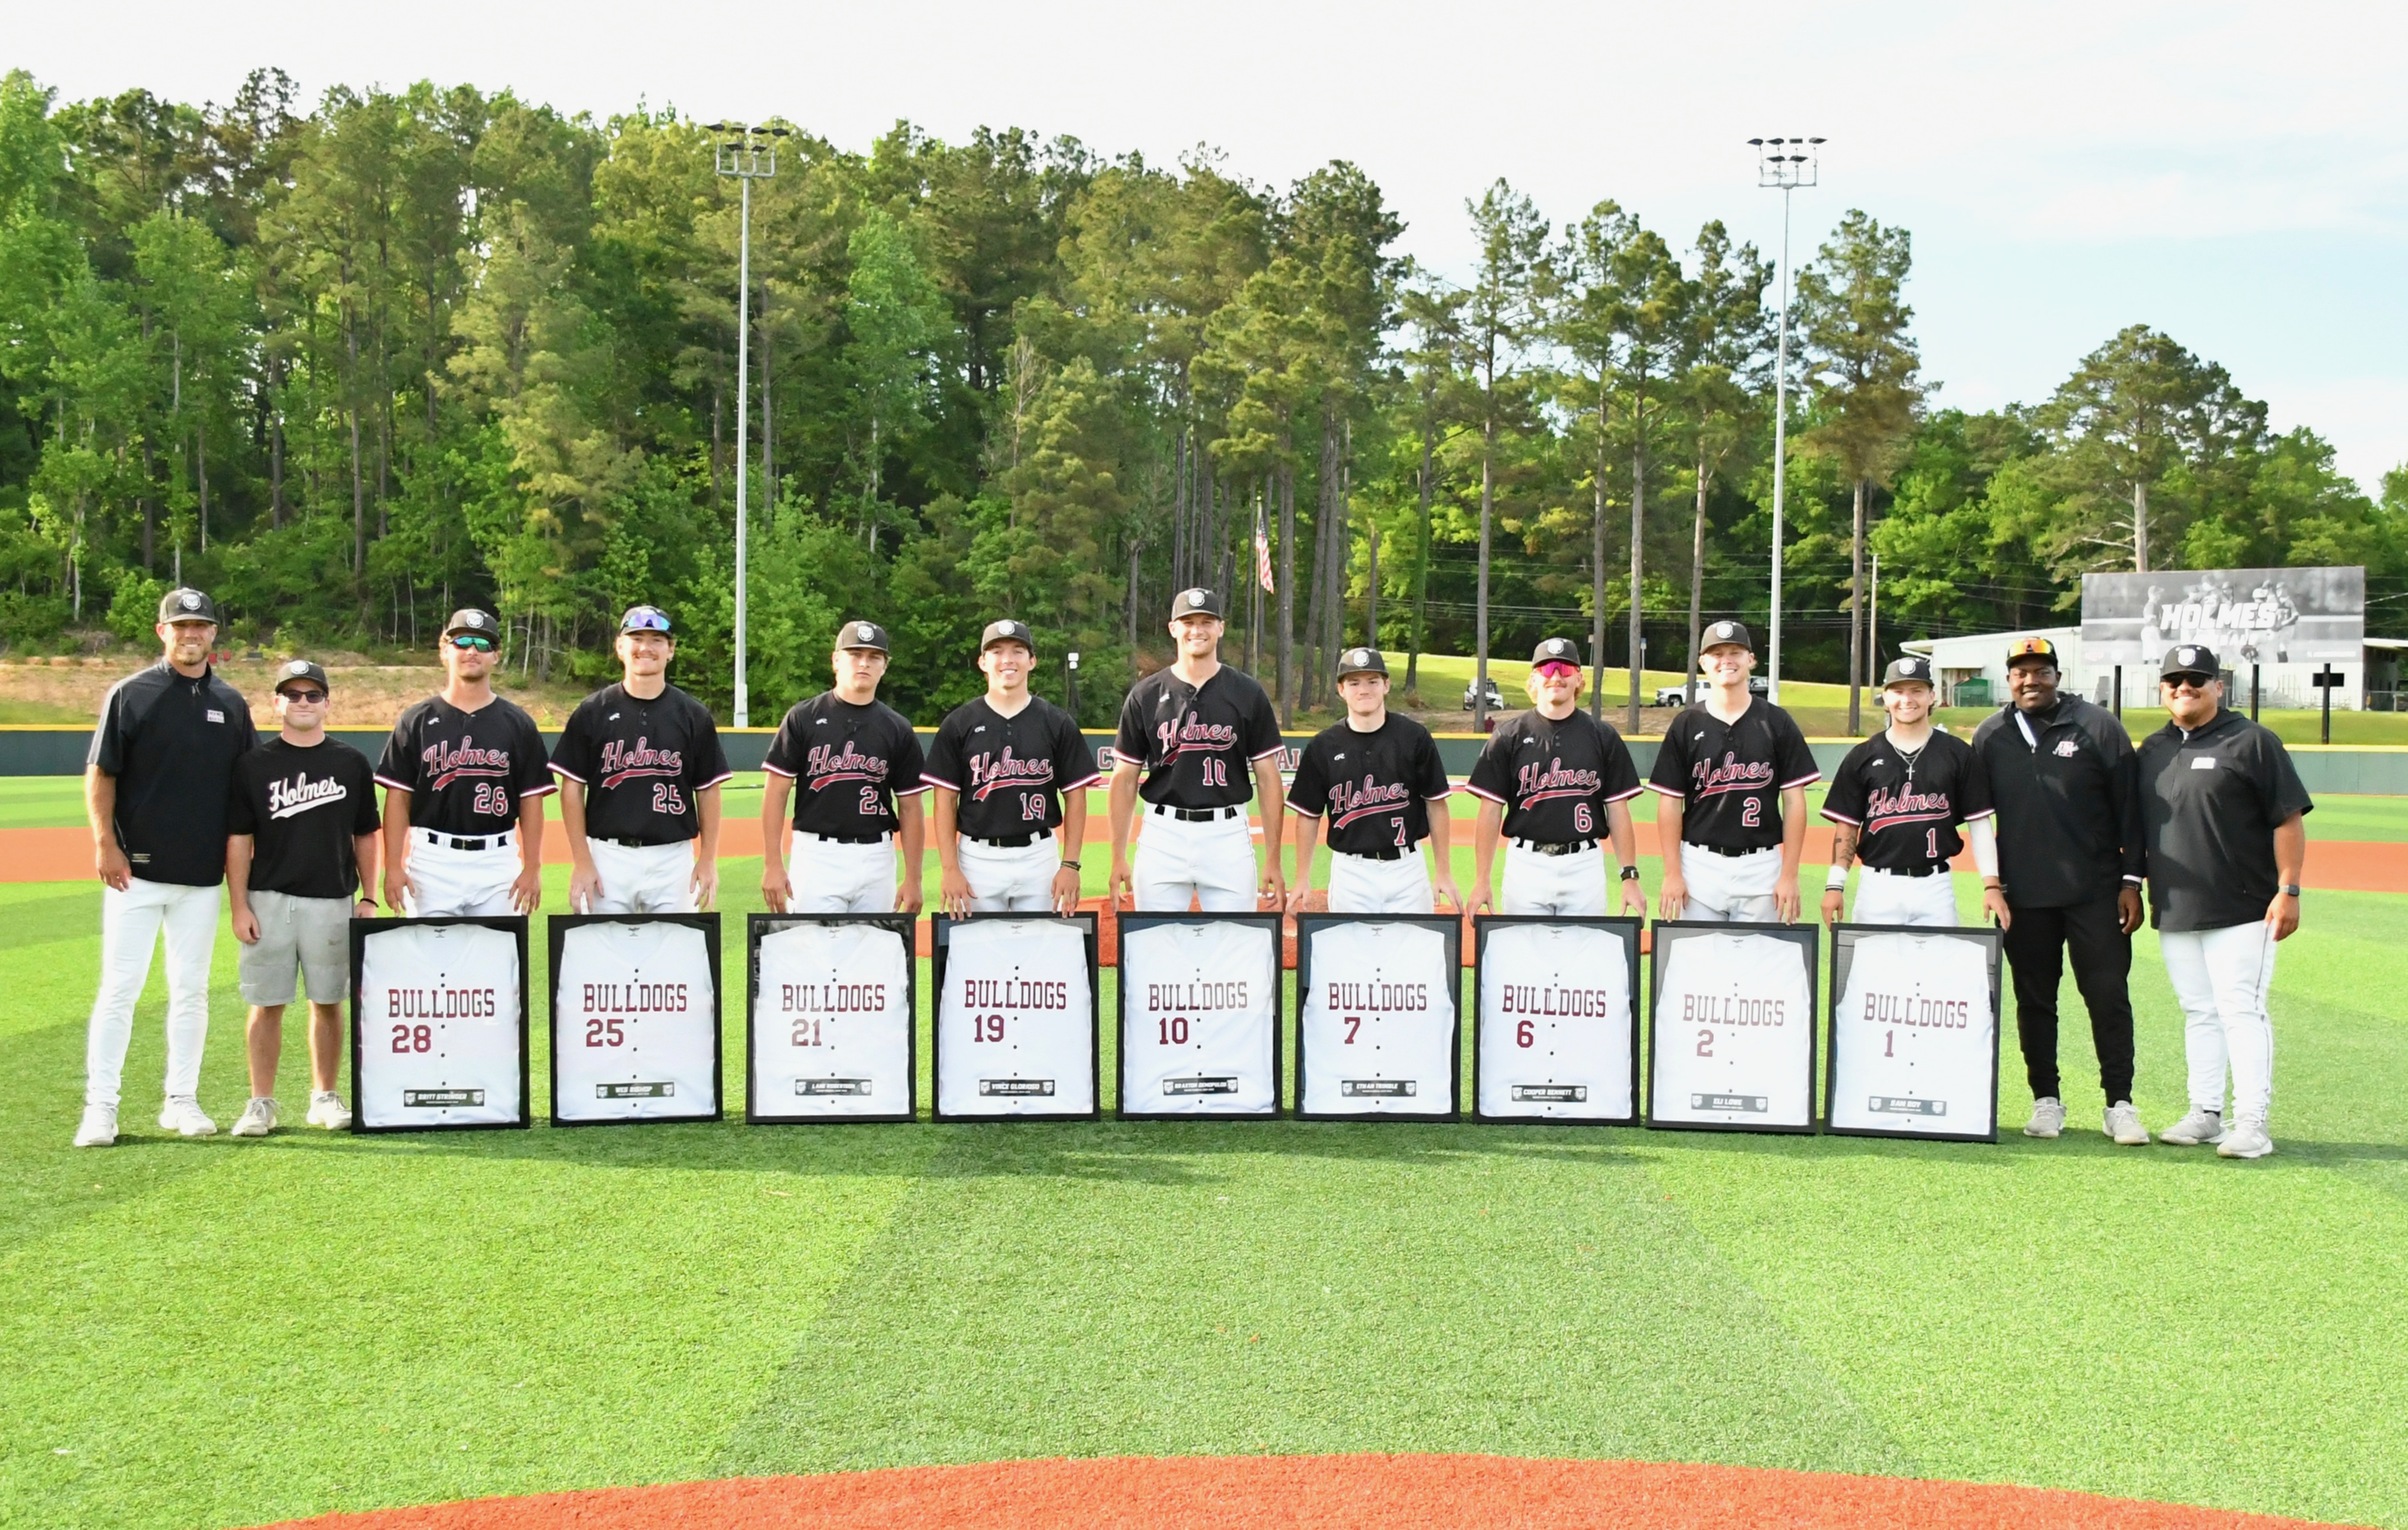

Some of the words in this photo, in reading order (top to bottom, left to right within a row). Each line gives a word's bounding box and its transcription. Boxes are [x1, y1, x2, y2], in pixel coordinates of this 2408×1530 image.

[2160, 602, 2279, 630] HOLMES
[1157, 711, 1237, 755] Holmes
[423, 736, 509, 778] Holmes
[601, 736, 683, 774] Holmes
[806, 740, 889, 777] Holmes
[969, 745, 1054, 787] Holmes
[1692, 751, 1774, 790] Holmes
[269, 772, 347, 812] Holmes
[1518, 757, 1601, 797] Holmes
[473, 782, 509, 817] 28
[652, 783, 686, 815] 25
[1019, 792, 1046, 820] 19
[1742, 796, 1761, 827] 2
[1867, 781, 1949, 818] Holmes
[1391, 816, 1406, 847] 7
[1574, 802, 1592, 833] 6
[1926, 827, 1938, 858] 1
[388, 988, 495, 1018] BULLDOGS
[583, 983, 688, 1012] BULLDOGS
[780, 984, 886, 1012] BULLDOGS
[965, 980, 1067, 1010] BULLDOGS
[1148, 981, 1248, 1011] BULLDOGS
[1328, 982, 1427, 1011] BULLDOGS
[1502, 984, 1607, 1018] BULLDOGS
[1683, 993, 1785, 1026] BULLDOGS
[1863, 992, 1968, 1029] BULLDOGS
[392, 1024, 431, 1053] 28
[586, 1019, 624, 1047] 25
[791, 1019, 822, 1046] 21
[974, 1014, 1005, 1042] 19
[1159, 1017, 1189, 1045] 10
[1344, 1017, 1361, 1044] 7
[1516, 1020, 1535, 1048] 6
[1696, 1029, 1715, 1057] 2
[1884, 1030, 1894, 1058] 1
